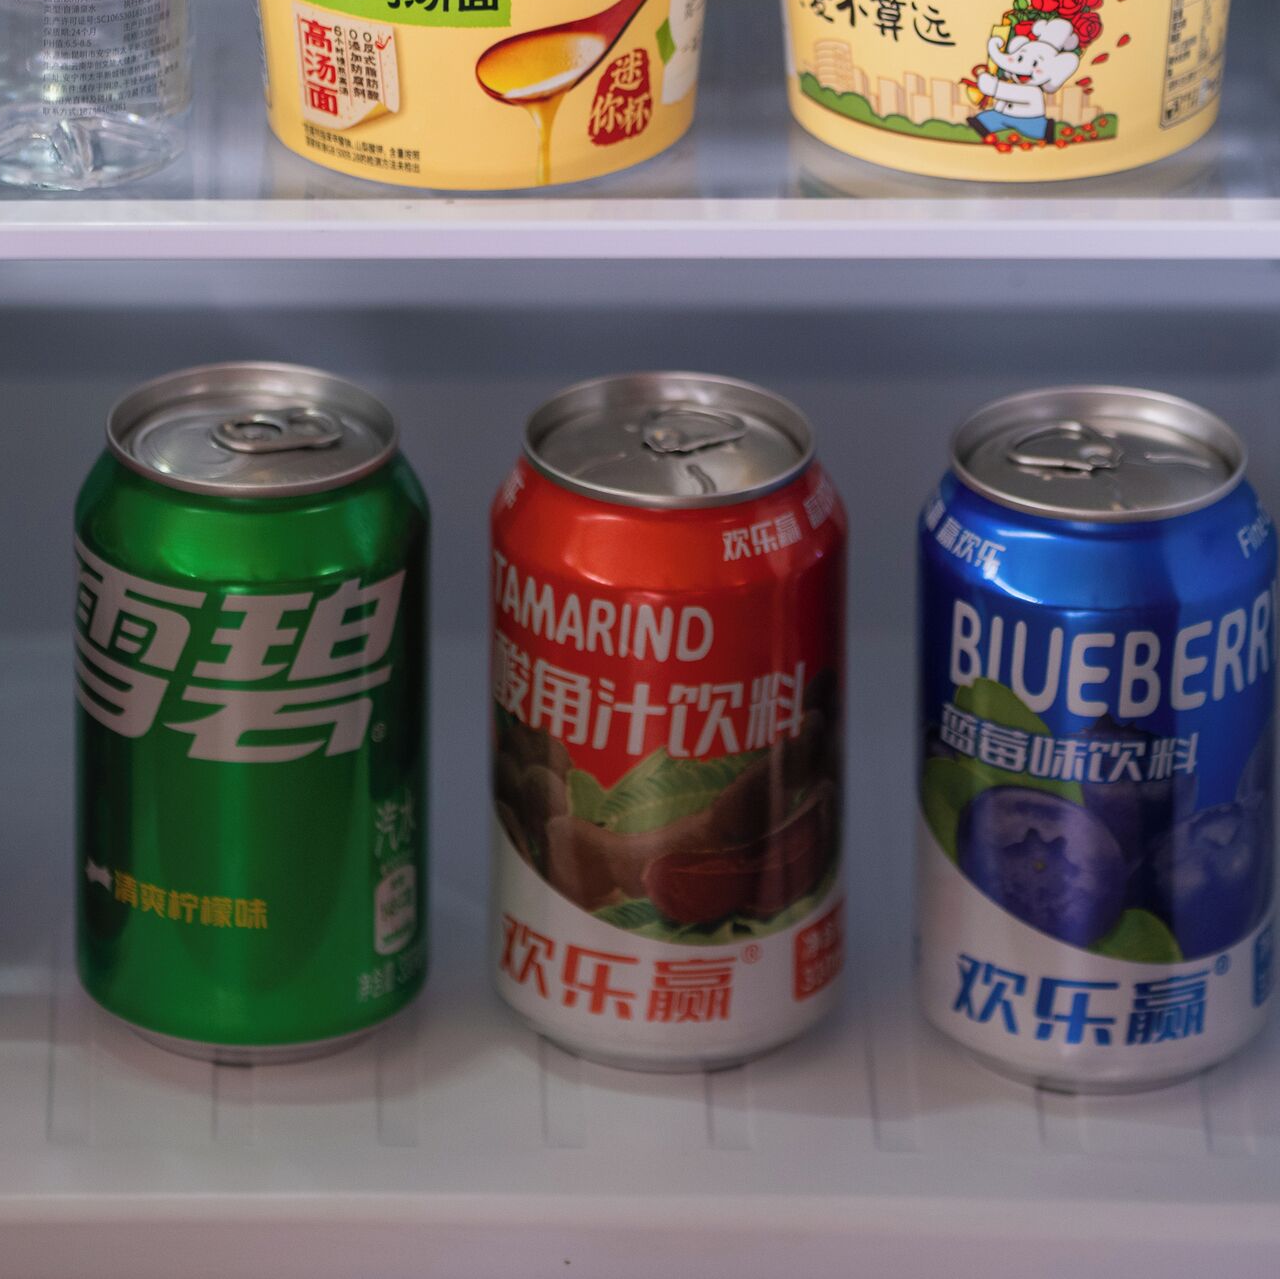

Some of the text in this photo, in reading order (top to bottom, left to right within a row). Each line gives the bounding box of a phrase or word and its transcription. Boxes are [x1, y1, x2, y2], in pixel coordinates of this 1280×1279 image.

[302, 18, 340, 118] 高汤面
[722, 510, 803, 562] 欢乐赢
[73, 535, 407, 764] 雪碧
[494, 549, 715, 663] TAMARIND
[494, 627, 806, 759] 酸角汁饮料
[940, 701, 1200, 785] 蓝莓味饮料
[114, 869, 269, 930] 清爽柠檬味
[502, 912, 738, 1023] 欢乐赢
[951, 951, 1213, 1048] 欢乐赢
